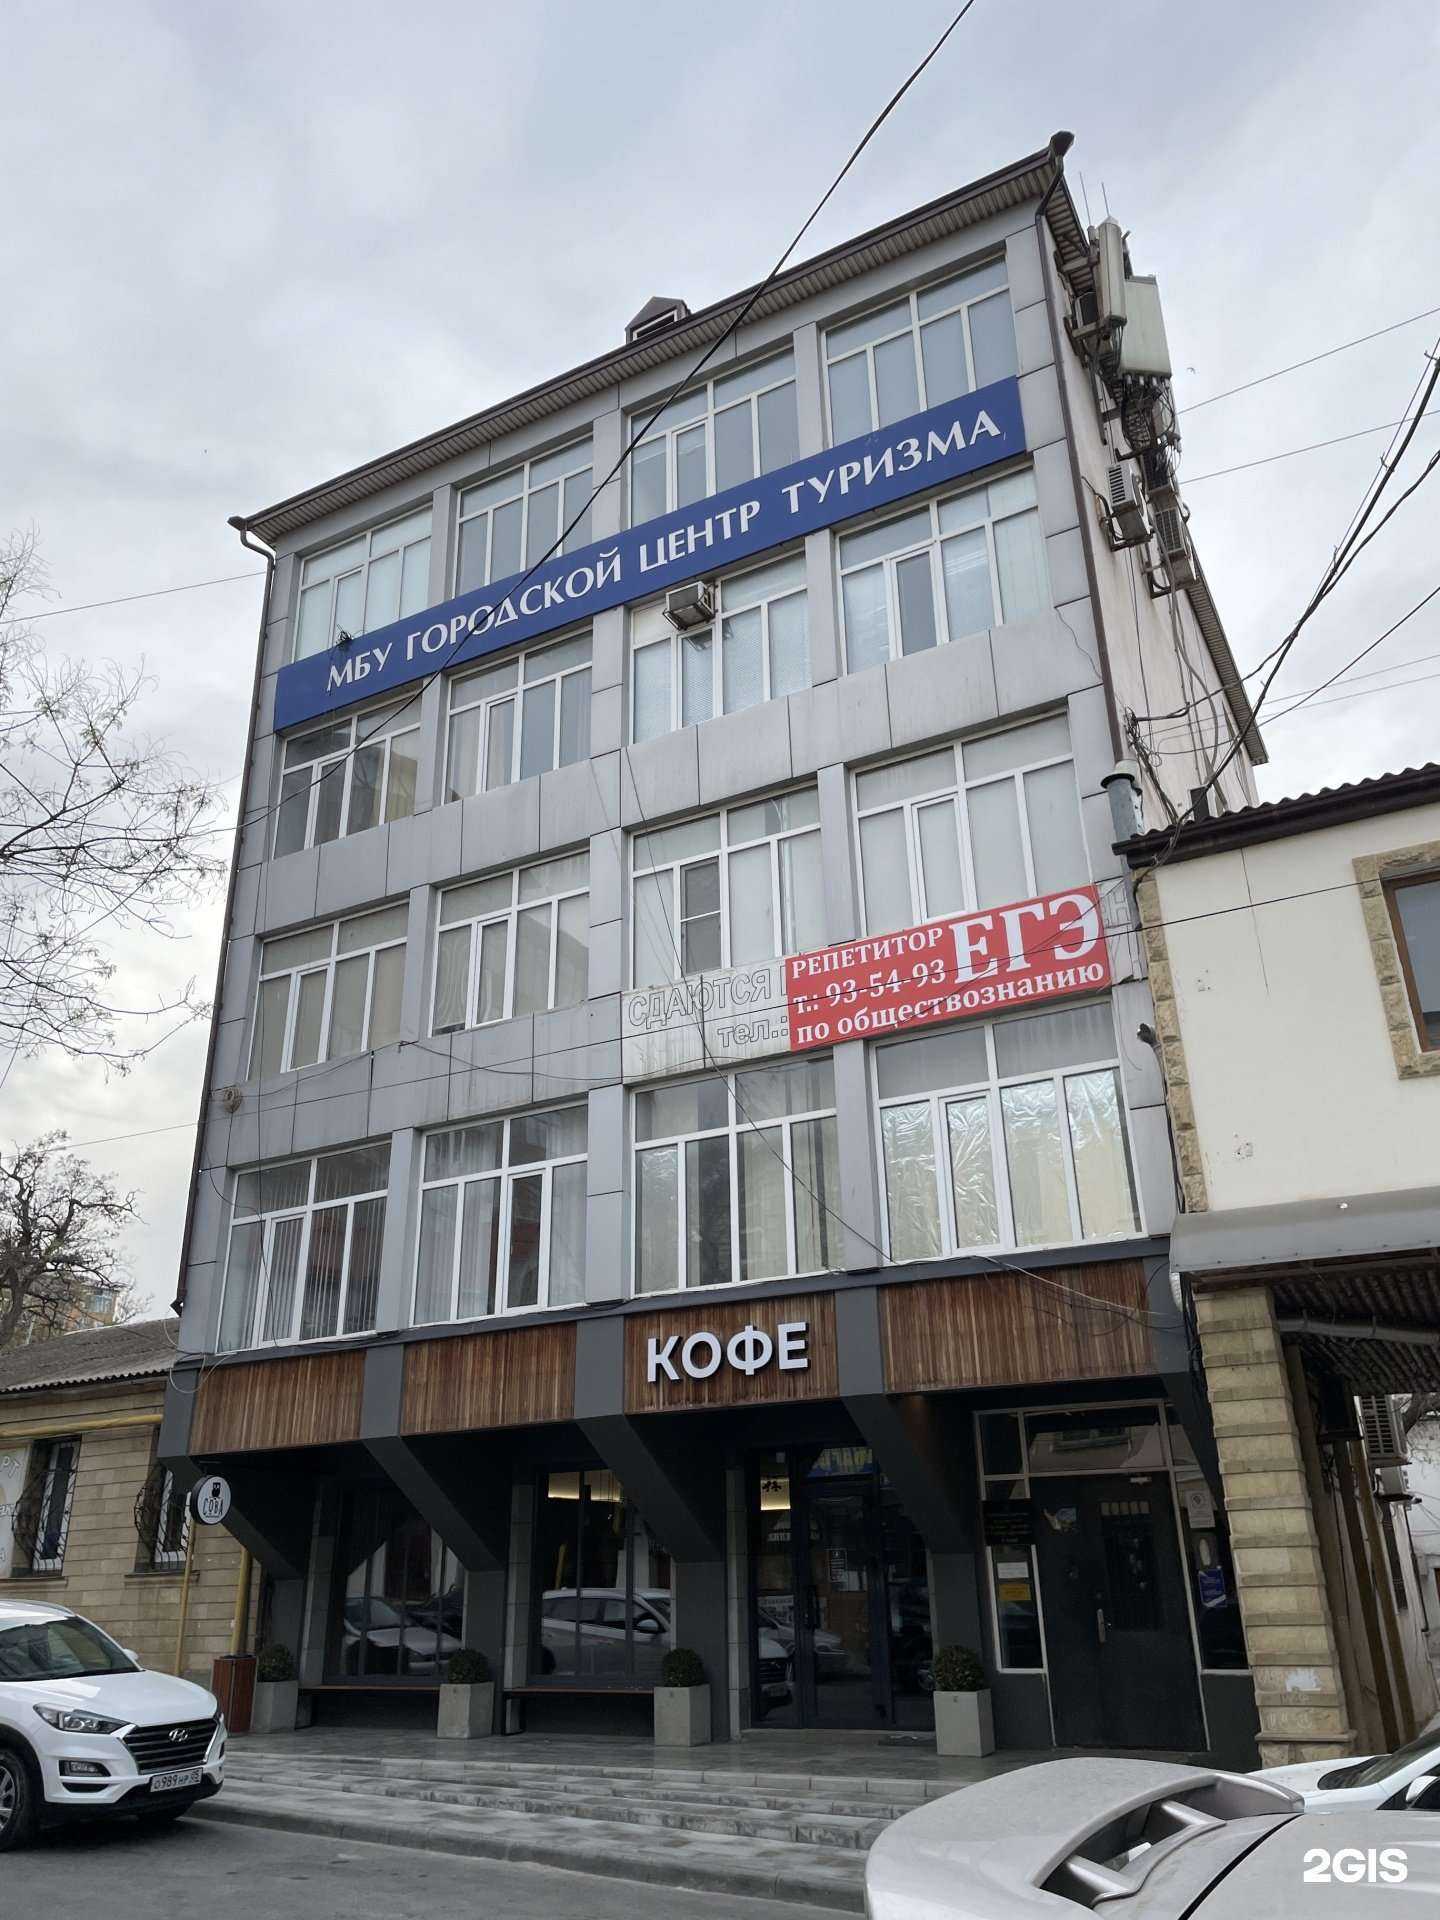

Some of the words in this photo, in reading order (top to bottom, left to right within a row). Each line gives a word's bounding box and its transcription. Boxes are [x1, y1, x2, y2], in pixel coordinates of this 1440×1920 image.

[326, 643, 392, 691] МБУ
[406, 547, 621, 661] ГОРОДСКОЙ
[639, 501, 760, 572] ЦЕНТР
[781, 411, 1000, 513] ТУРИЗМА
[792, 928, 943, 979] РЕПЕТИТОР
[949, 894, 1099, 984] ЕГЭ
[629, 969, 771, 1029] СДАЮТСЯ
[797, 1023, 829, 1044] по
[837, 963, 1104, 1029] обществознанию
[826, 959, 946, 1006] 93-54-93
[647, 1322, 808, 1382] КОФЕ
